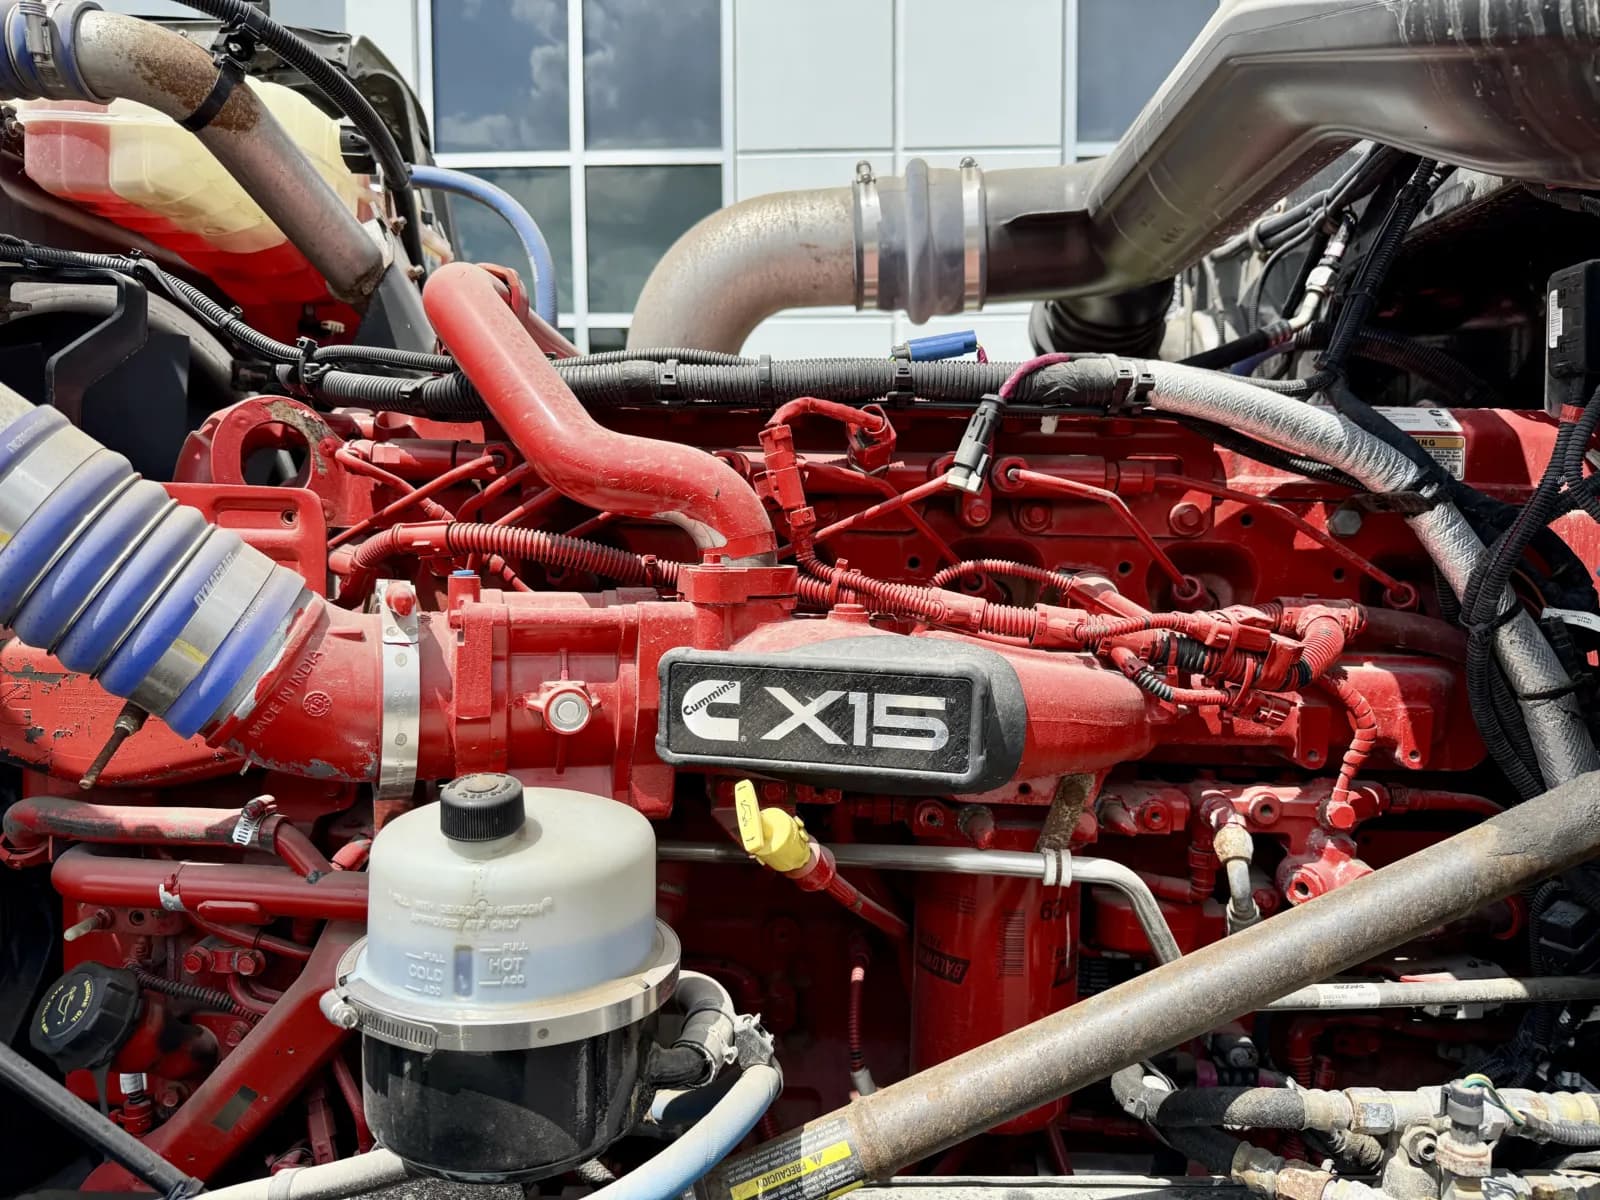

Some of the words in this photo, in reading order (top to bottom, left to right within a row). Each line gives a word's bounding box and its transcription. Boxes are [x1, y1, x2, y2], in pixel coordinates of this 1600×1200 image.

[277, 686, 295, 705] IN
[290, 650, 323, 687] INDIA
[683, 681, 736, 716] Cummins
[760, 687, 950, 750] X15
[408, 963, 443, 982] COLD
[488, 957, 524, 972] HOT
